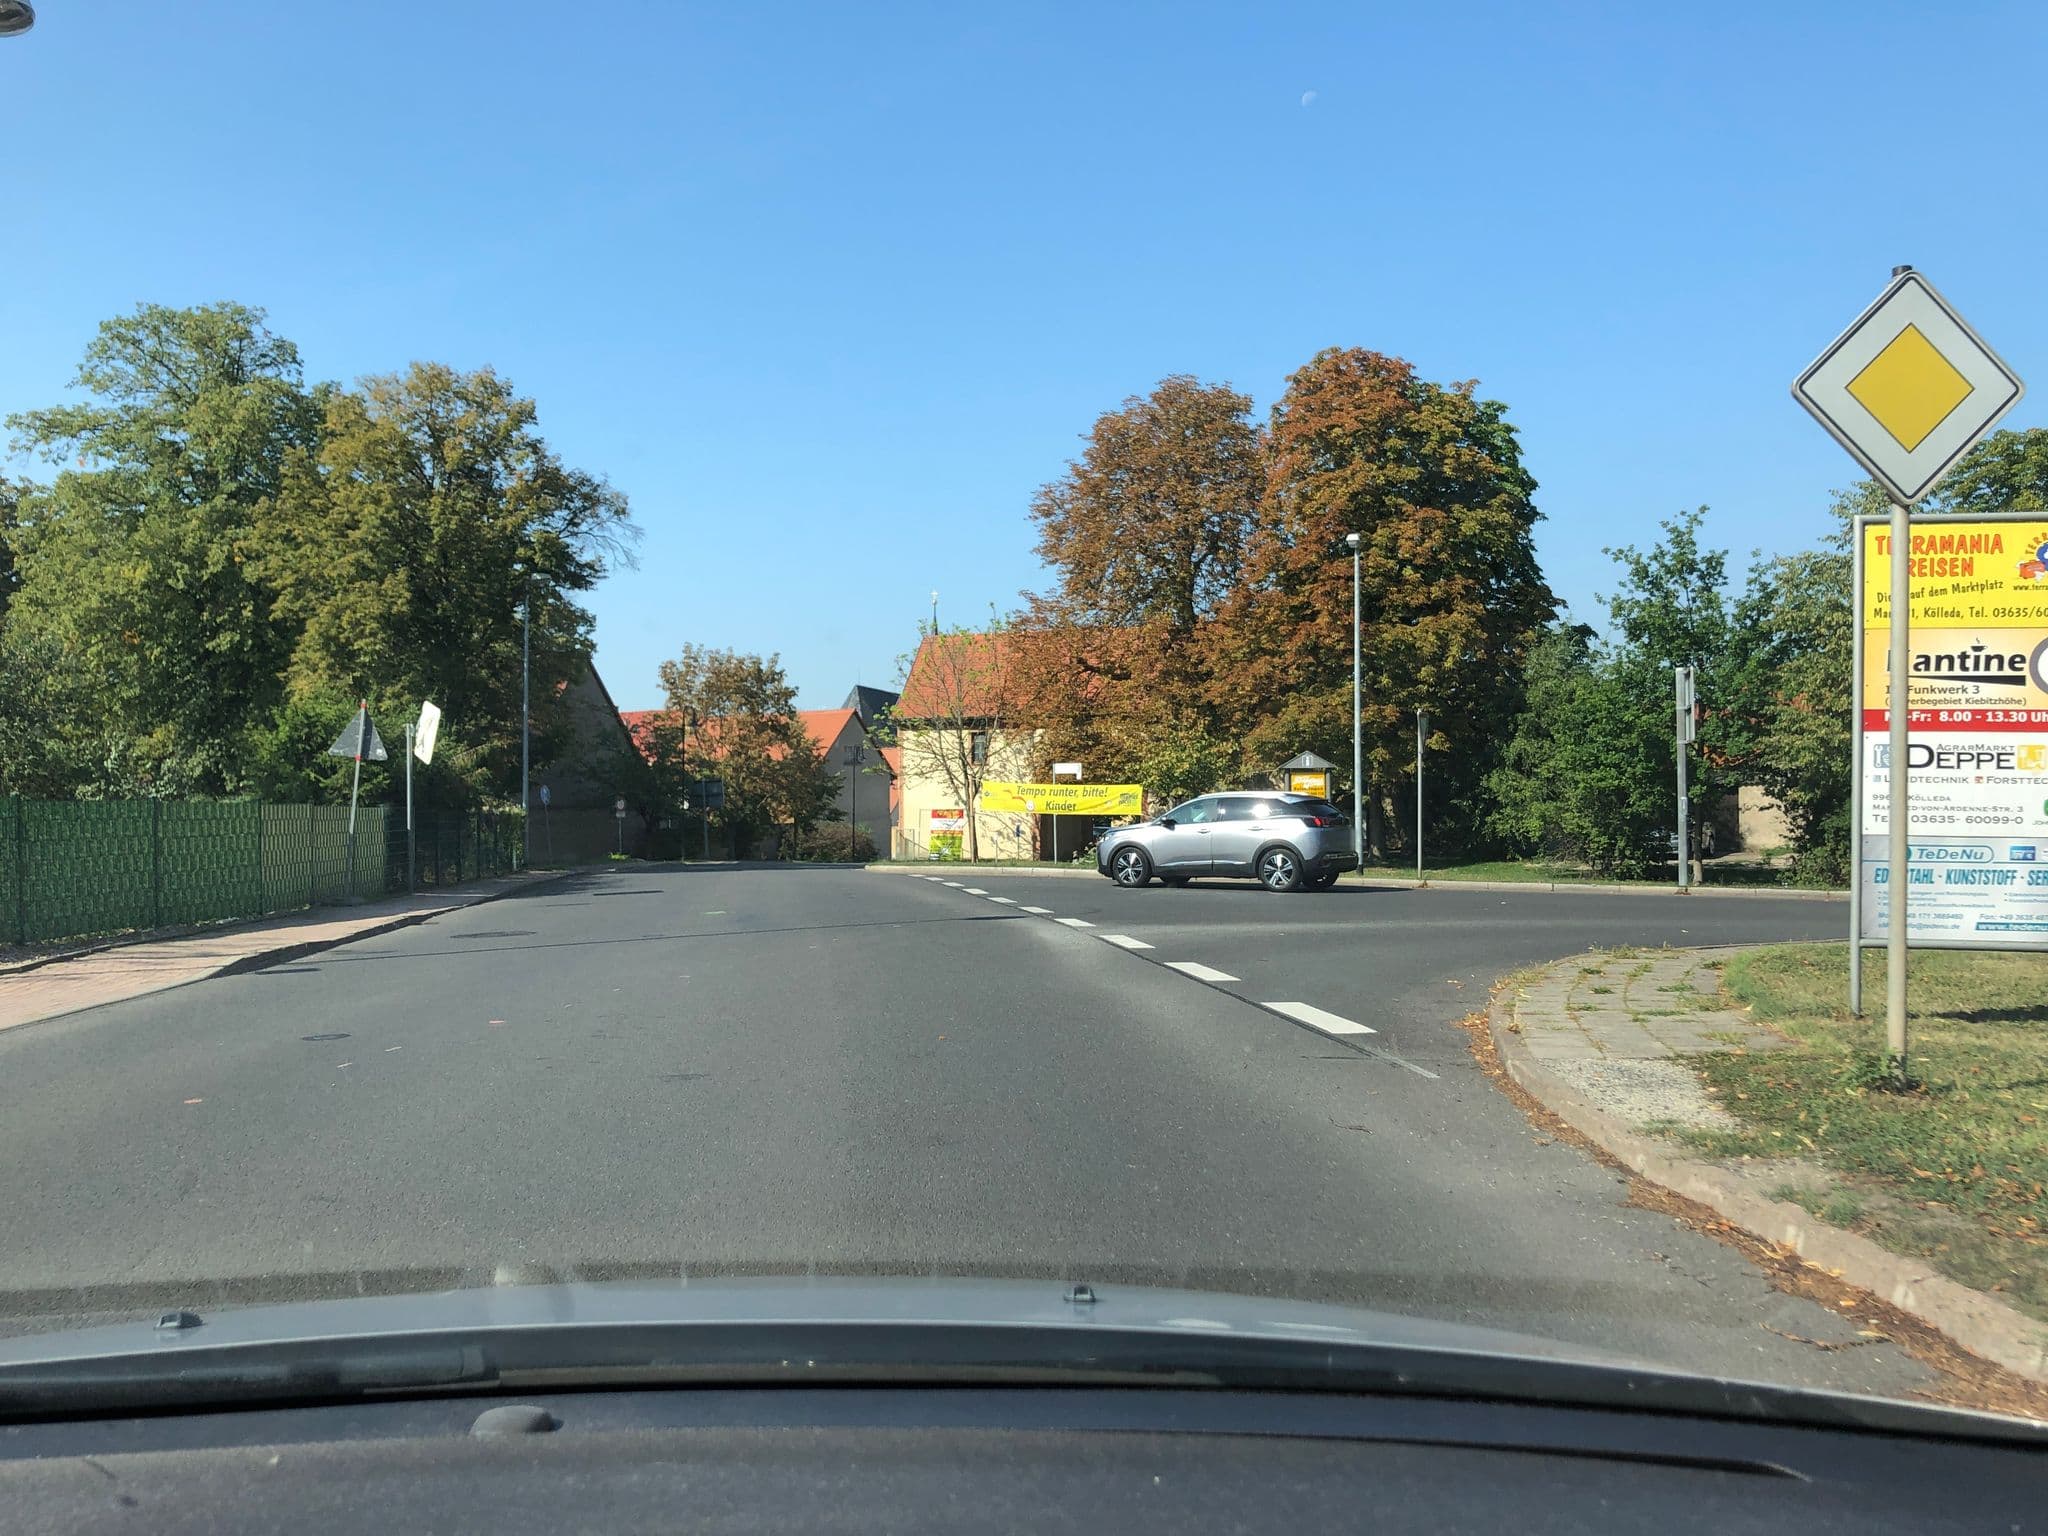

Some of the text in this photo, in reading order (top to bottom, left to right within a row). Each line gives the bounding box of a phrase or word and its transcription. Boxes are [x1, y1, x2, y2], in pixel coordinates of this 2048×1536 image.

[1910, 587, 1925, 599] auf
[1929, 586, 1948, 597] dem
[1952, 579, 2003, 594] Marktplatz
[1923, 607, 1964, 619] Kölleda,
[1969, 607, 1988, 617] Tel.
[1887, 650, 2026, 672] antine
[1972, 685, 1980, 695] 3
[1965, 697, 2027, 706] Kiebitzhöhe)
[1939, 711, 1972, 722] 8.00
[1986, 711, 2027, 722] 13.30
[1907, 744, 2015, 769] DEPPE
[1017, 786, 1108, 798] Tempo runter, bitte!
[1045, 801, 1077, 812] Kinder
[1965, 815, 2024, 825] 60099-0
[1917, 848, 1984, 860] TeDeNu
[1945, 869, 2018, 886] KUNSTSTOFF
